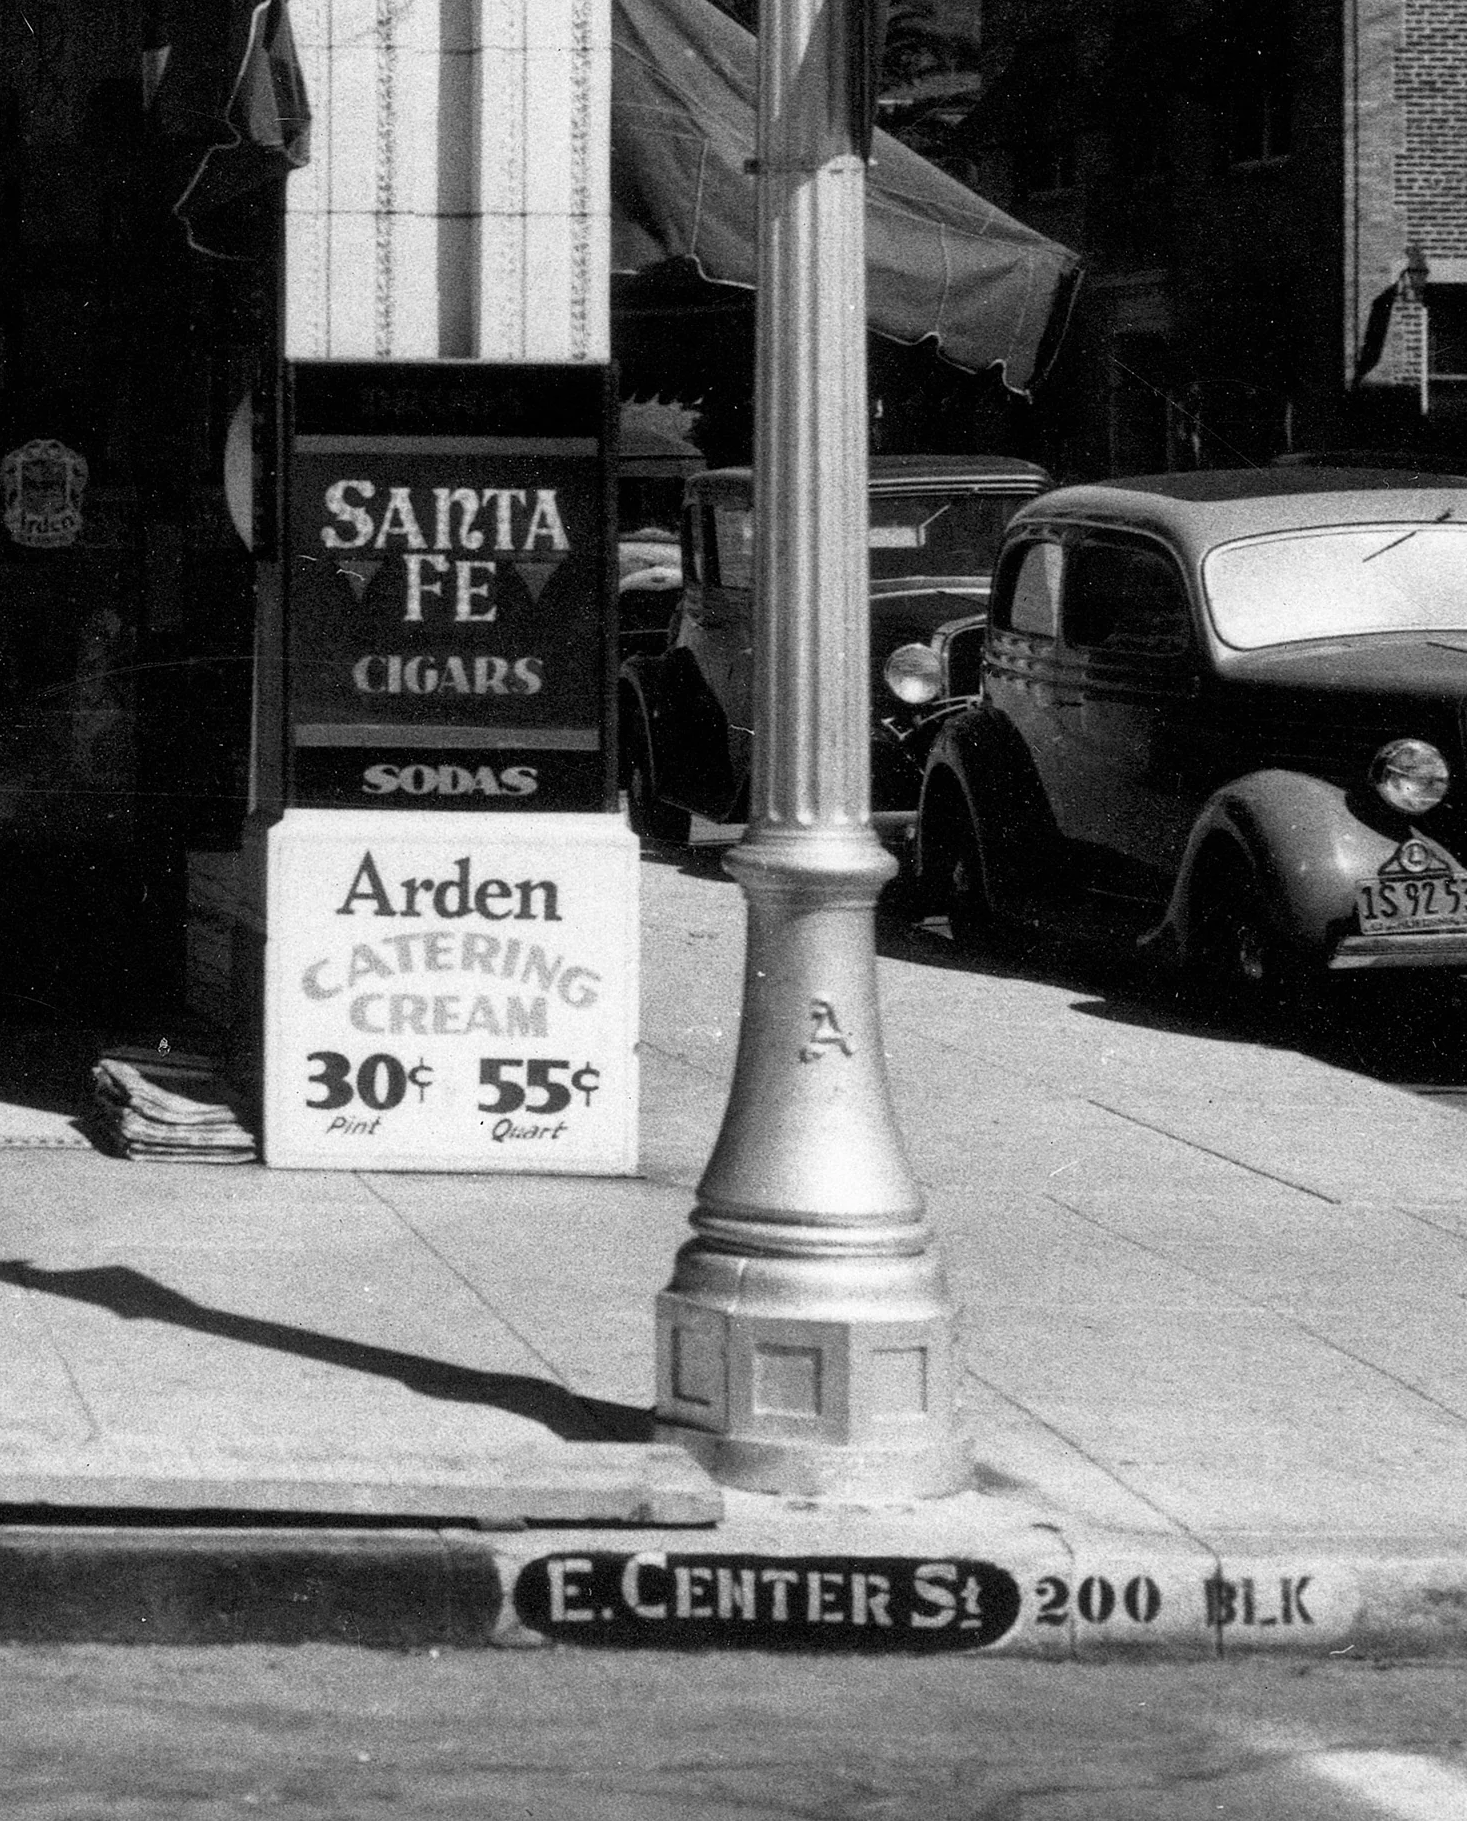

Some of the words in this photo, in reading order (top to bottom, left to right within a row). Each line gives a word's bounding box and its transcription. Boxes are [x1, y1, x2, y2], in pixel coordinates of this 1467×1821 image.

[321, 478, 570, 551] SANTA
[402, 553, 497, 623] FE
[353, 655, 544, 696] CIGARS
[362, 763, 539, 796] SODAS
[336, 850, 563, 922] Arden
[301, 931, 603, 1009] CATERING
[349, 992, 549, 1039] CREAM
[305, 1051, 435, 1112] 30¢
[477, 1057, 601, 1115] 55¢
[326, 1115, 382, 1137] Pint
[490, 1118, 569, 1144] Quart
[547, 1558, 613, 1624] E.
[621, 1551, 892, 1628] CENTER
[1032, 1574, 1163, 1629] 200
[1204, 1574, 1317, 1628] BLK
